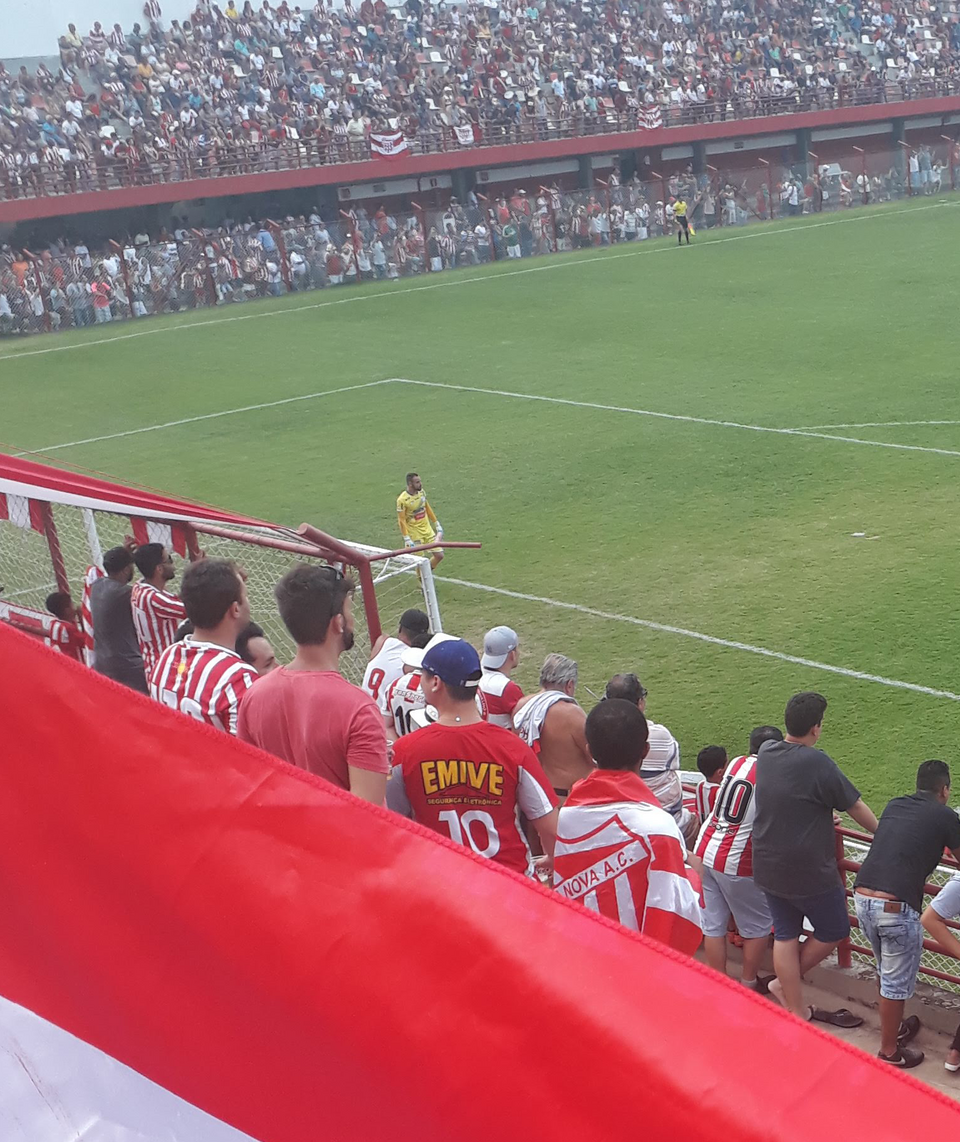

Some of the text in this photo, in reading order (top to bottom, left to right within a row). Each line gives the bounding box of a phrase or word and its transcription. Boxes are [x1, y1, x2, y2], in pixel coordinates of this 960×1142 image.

[368, 667, 386, 700] 9
[420, 759, 504, 797] EMIVE
[716, 774, 754, 825] 10
[438, 809, 500, 859] 10
[563, 851, 635, 898] NOVA A.C.
